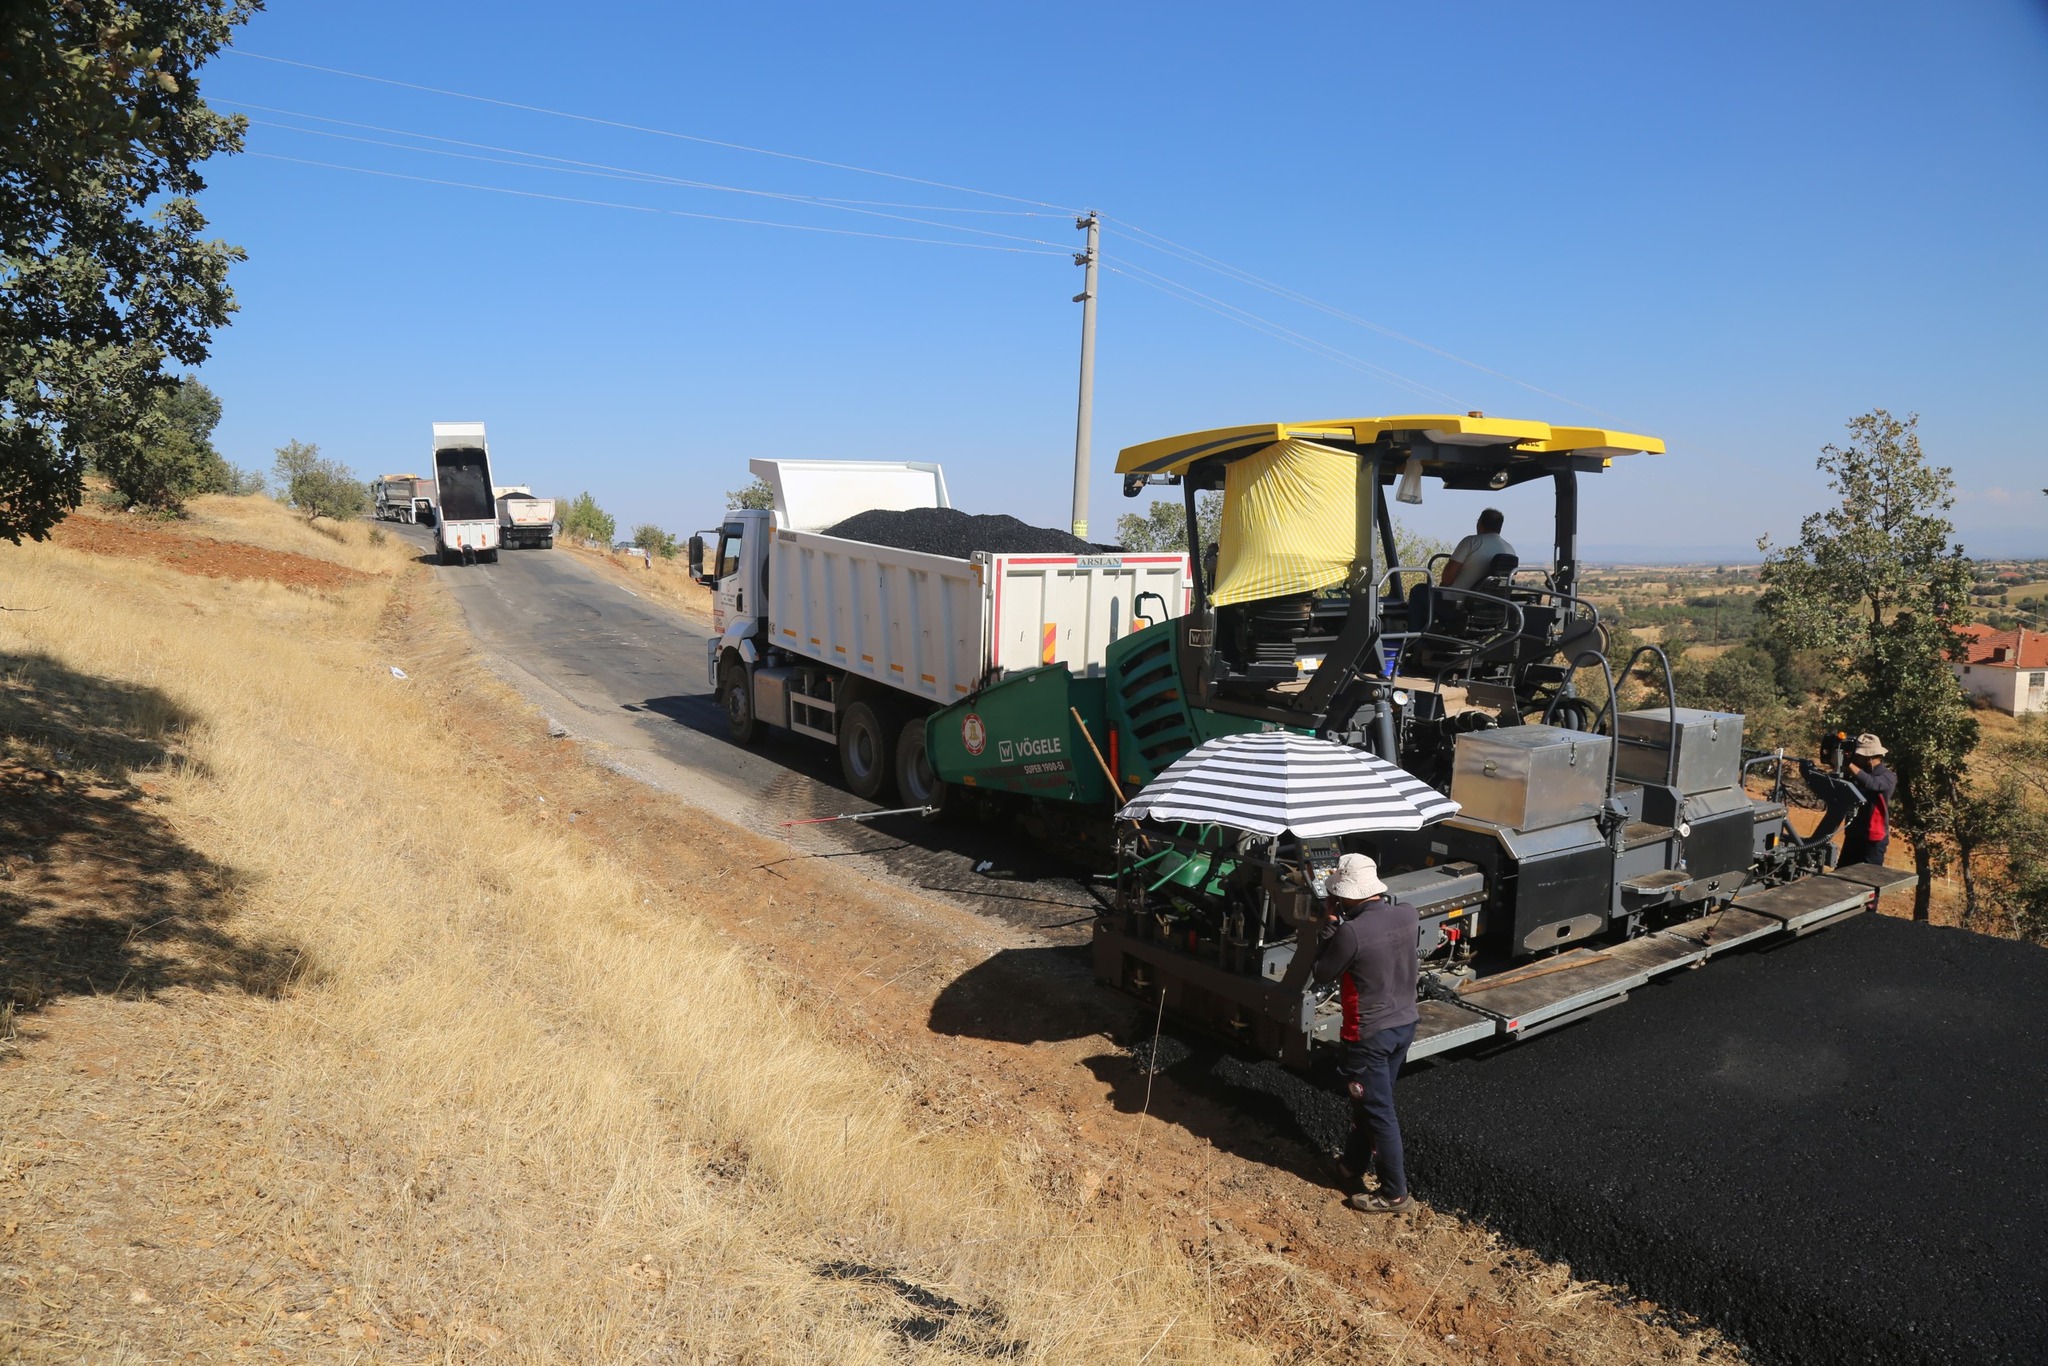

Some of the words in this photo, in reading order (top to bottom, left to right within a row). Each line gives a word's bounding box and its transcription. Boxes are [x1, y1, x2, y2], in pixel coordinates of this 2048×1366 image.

[1080, 557, 1120, 566] ARSLAN
[1015, 737, 1061, 757] VÖGELE
[1024, 764, 1042, 774] SUPER
